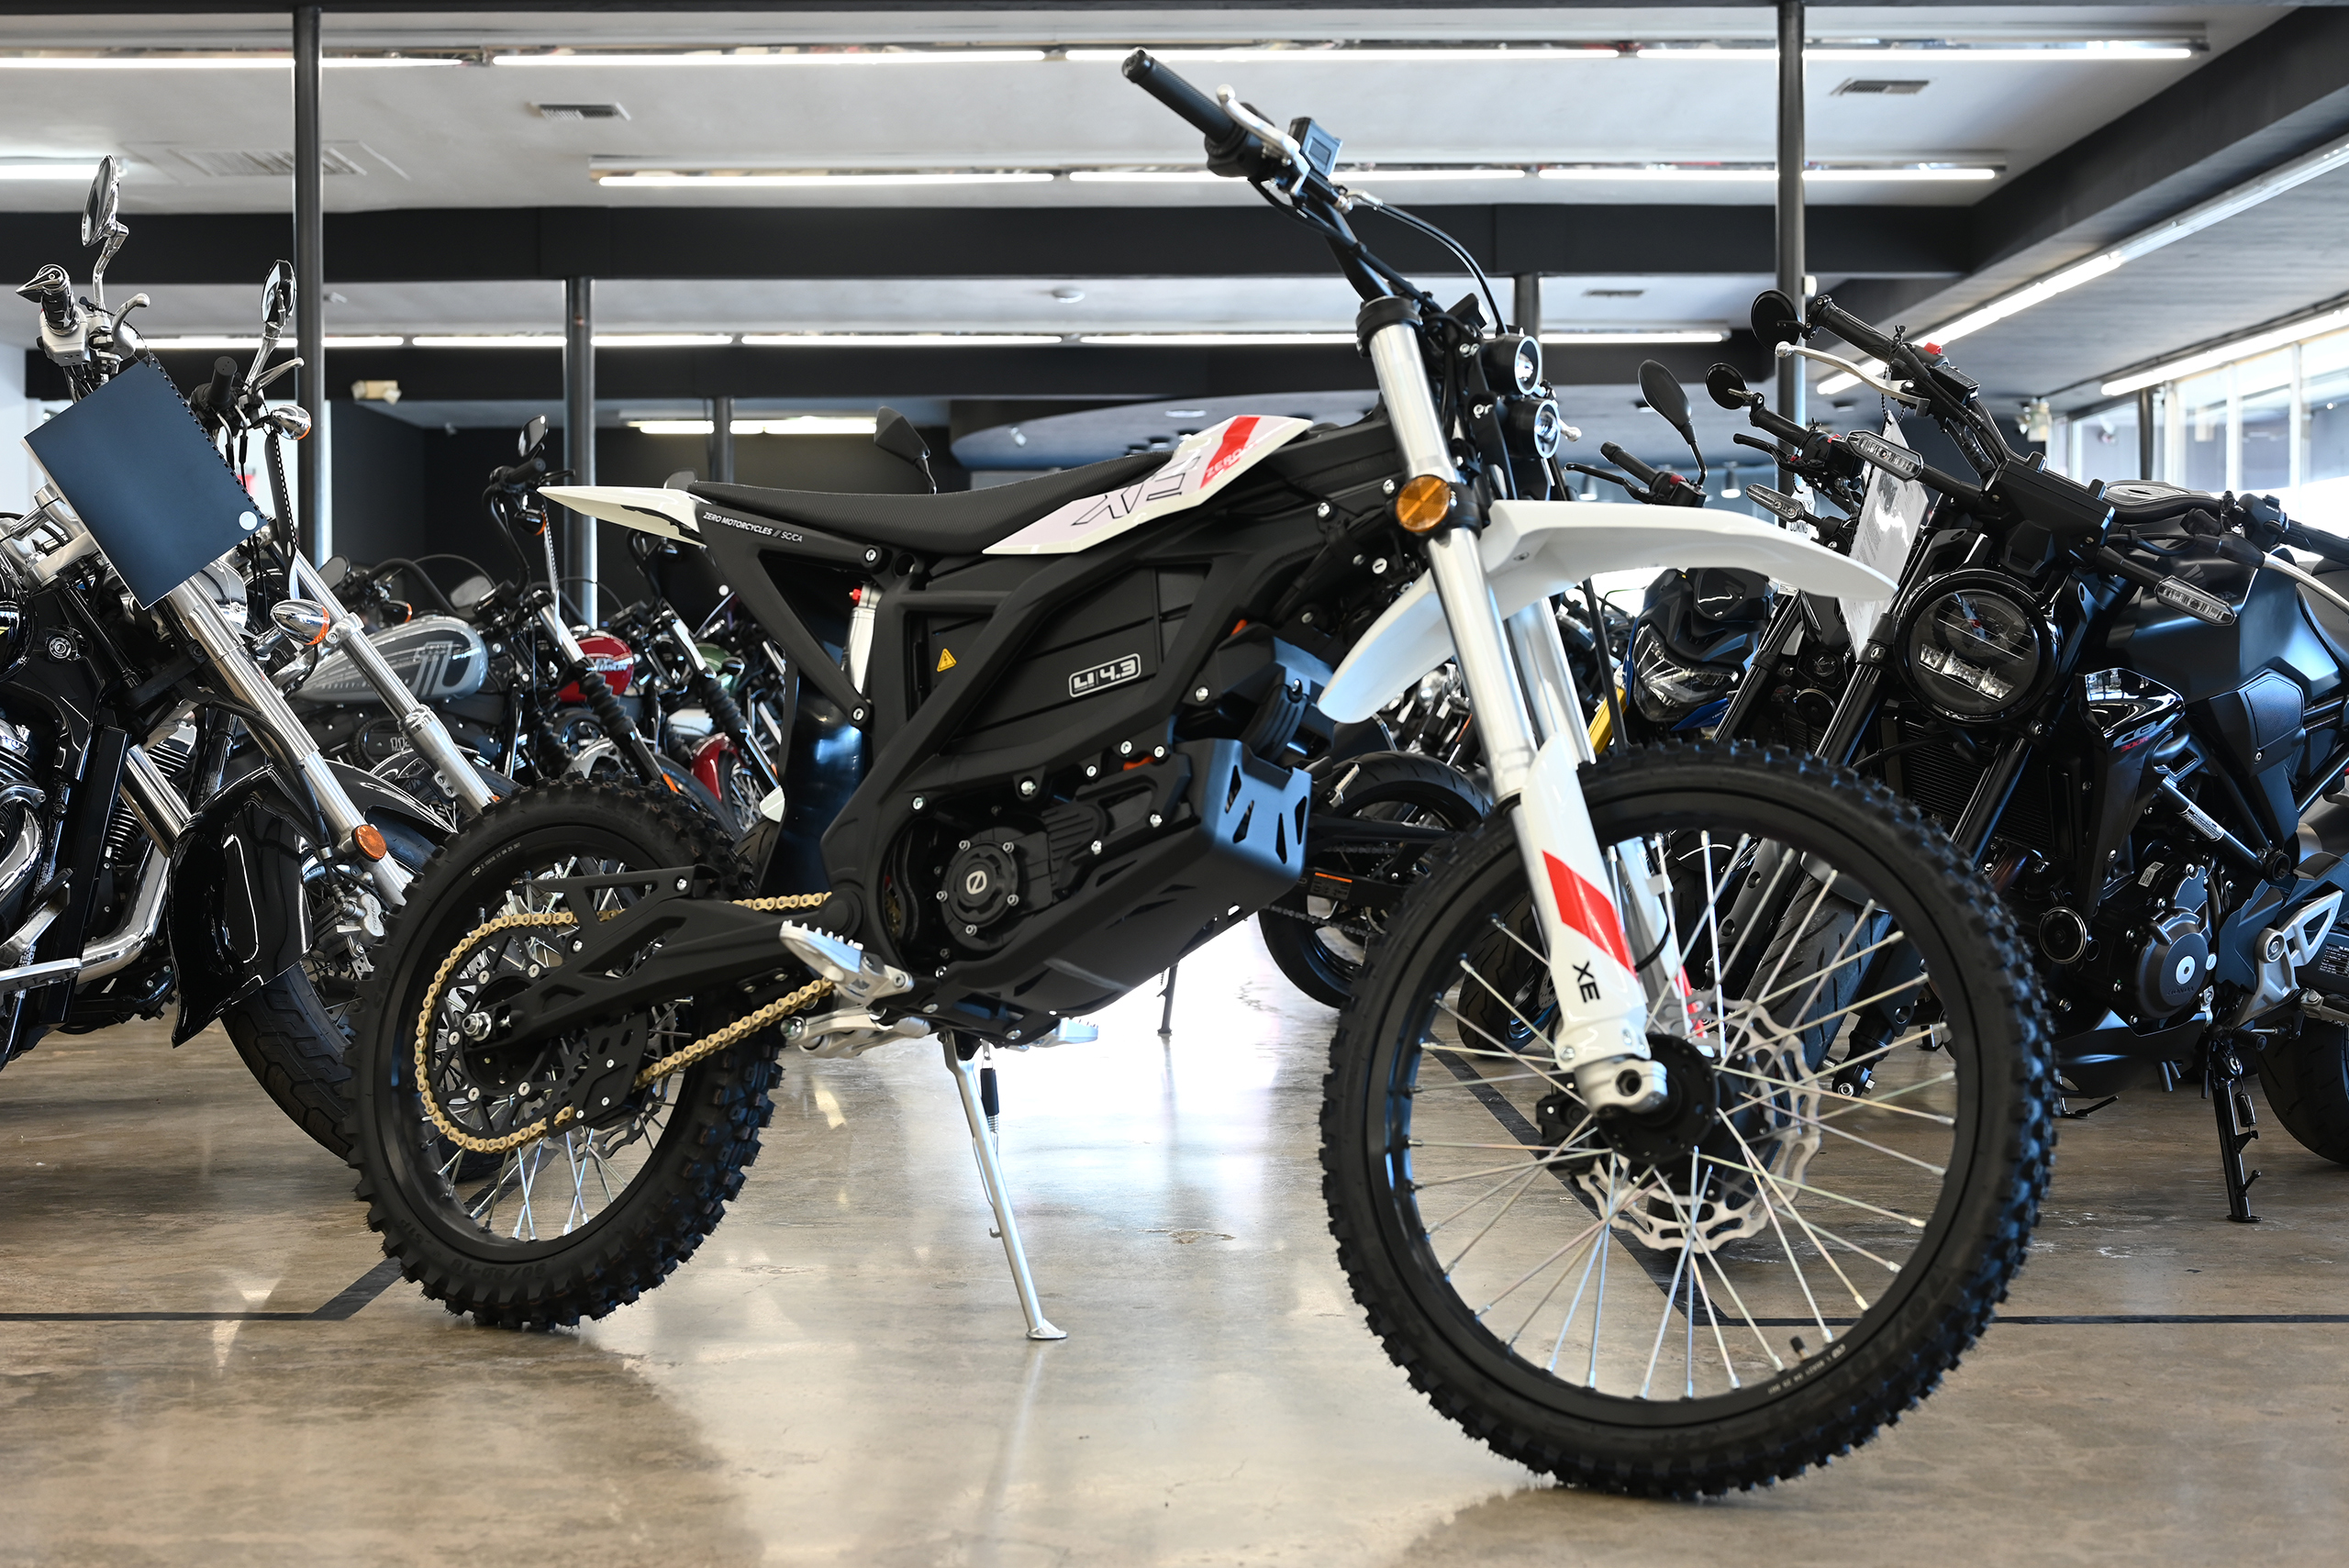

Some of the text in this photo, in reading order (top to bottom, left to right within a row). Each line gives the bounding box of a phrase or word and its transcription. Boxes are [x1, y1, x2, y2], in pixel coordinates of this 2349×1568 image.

[1206, 447, 1244, 478] ZERO
[703, 512, 722, 523] ZERO
[721, 517, 773, 536] MOTORCYCLES
[1074, 672, 1095, 689] LI
[1099, 659, 1136, 681] 4.3
[2113, 720, 2158, 748] CB
[1572, 961, 1600, 1003] XE
